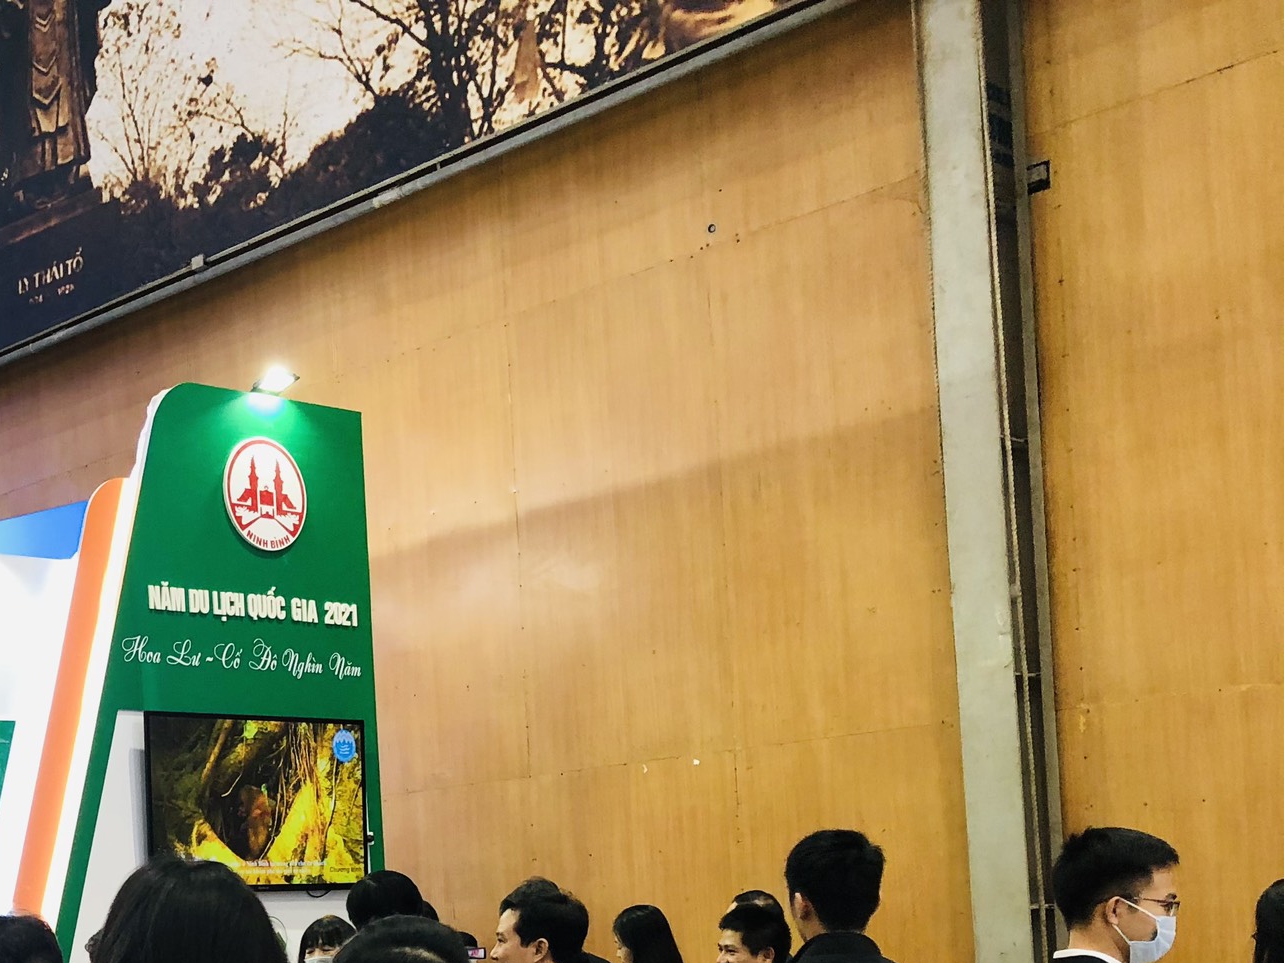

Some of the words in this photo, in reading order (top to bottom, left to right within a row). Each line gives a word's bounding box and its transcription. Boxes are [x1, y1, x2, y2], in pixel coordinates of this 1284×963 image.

[246, 529, 268, 548] NINH
[270, 535, 290, 548] BÌNH
[148, 581, 186, 612] NĂM
[188, 588, 210, 615] DU
[212, 590, 245, 622] LỊCH
[247, 586, 286, 620] QUỐC
[291, 597, 318, 623] GIA
[323, 601, 358, 627] 2021
[121, 635, 161, 664] Hoa
[214, 642, 243, 669] Cố
[248, 638, 277, 671] Đô
[281, 648, 323, 680] Nghìn
[328, 652, 362, 680] Năm
